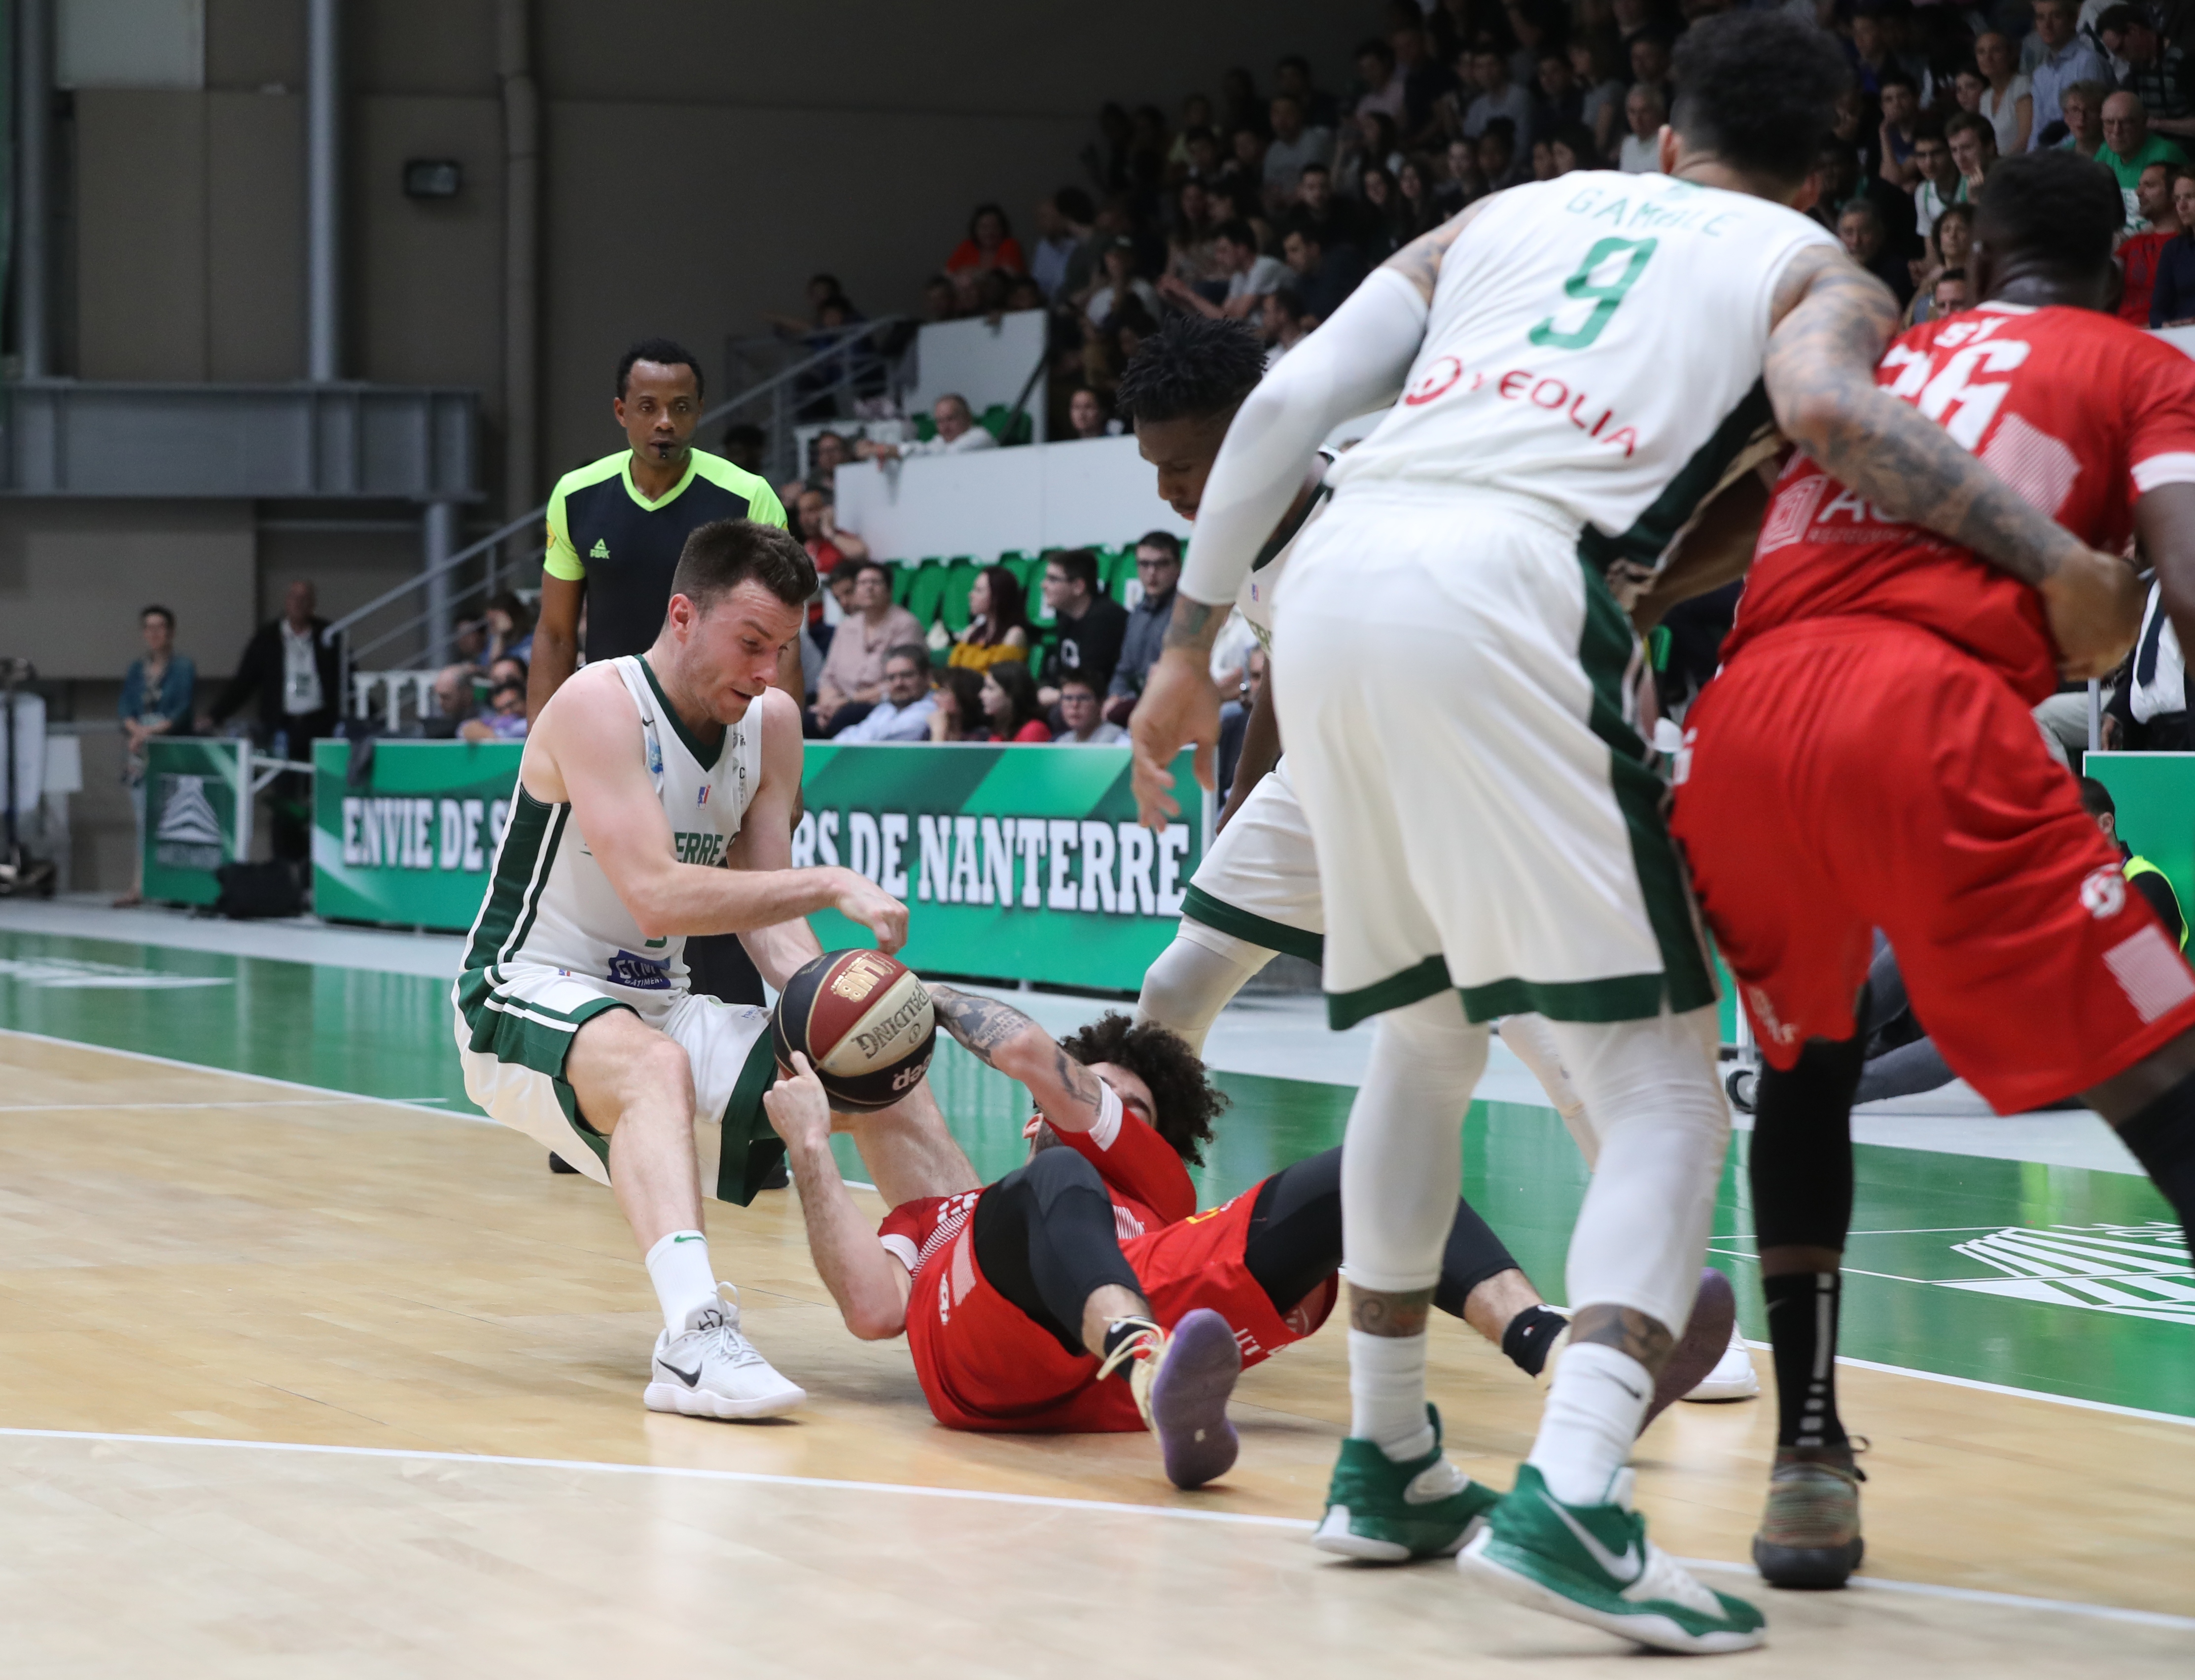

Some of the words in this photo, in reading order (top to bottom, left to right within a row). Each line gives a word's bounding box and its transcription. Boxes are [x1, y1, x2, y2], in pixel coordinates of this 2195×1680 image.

[1529, 238, 1659, 350] 9
[1933, 315, 2010, 348] SY
[343, 796, 434, 869] ENVIE
[438, 798, 485, 872] DE
[849, 811, 908, 899] DE
[918, 814, 1190, 917] NANTERRE
[615, 959, 656, 980] GTM
[851, 978, 930, 1059] PALDING
[892, 1053, 932, 1090] eep
